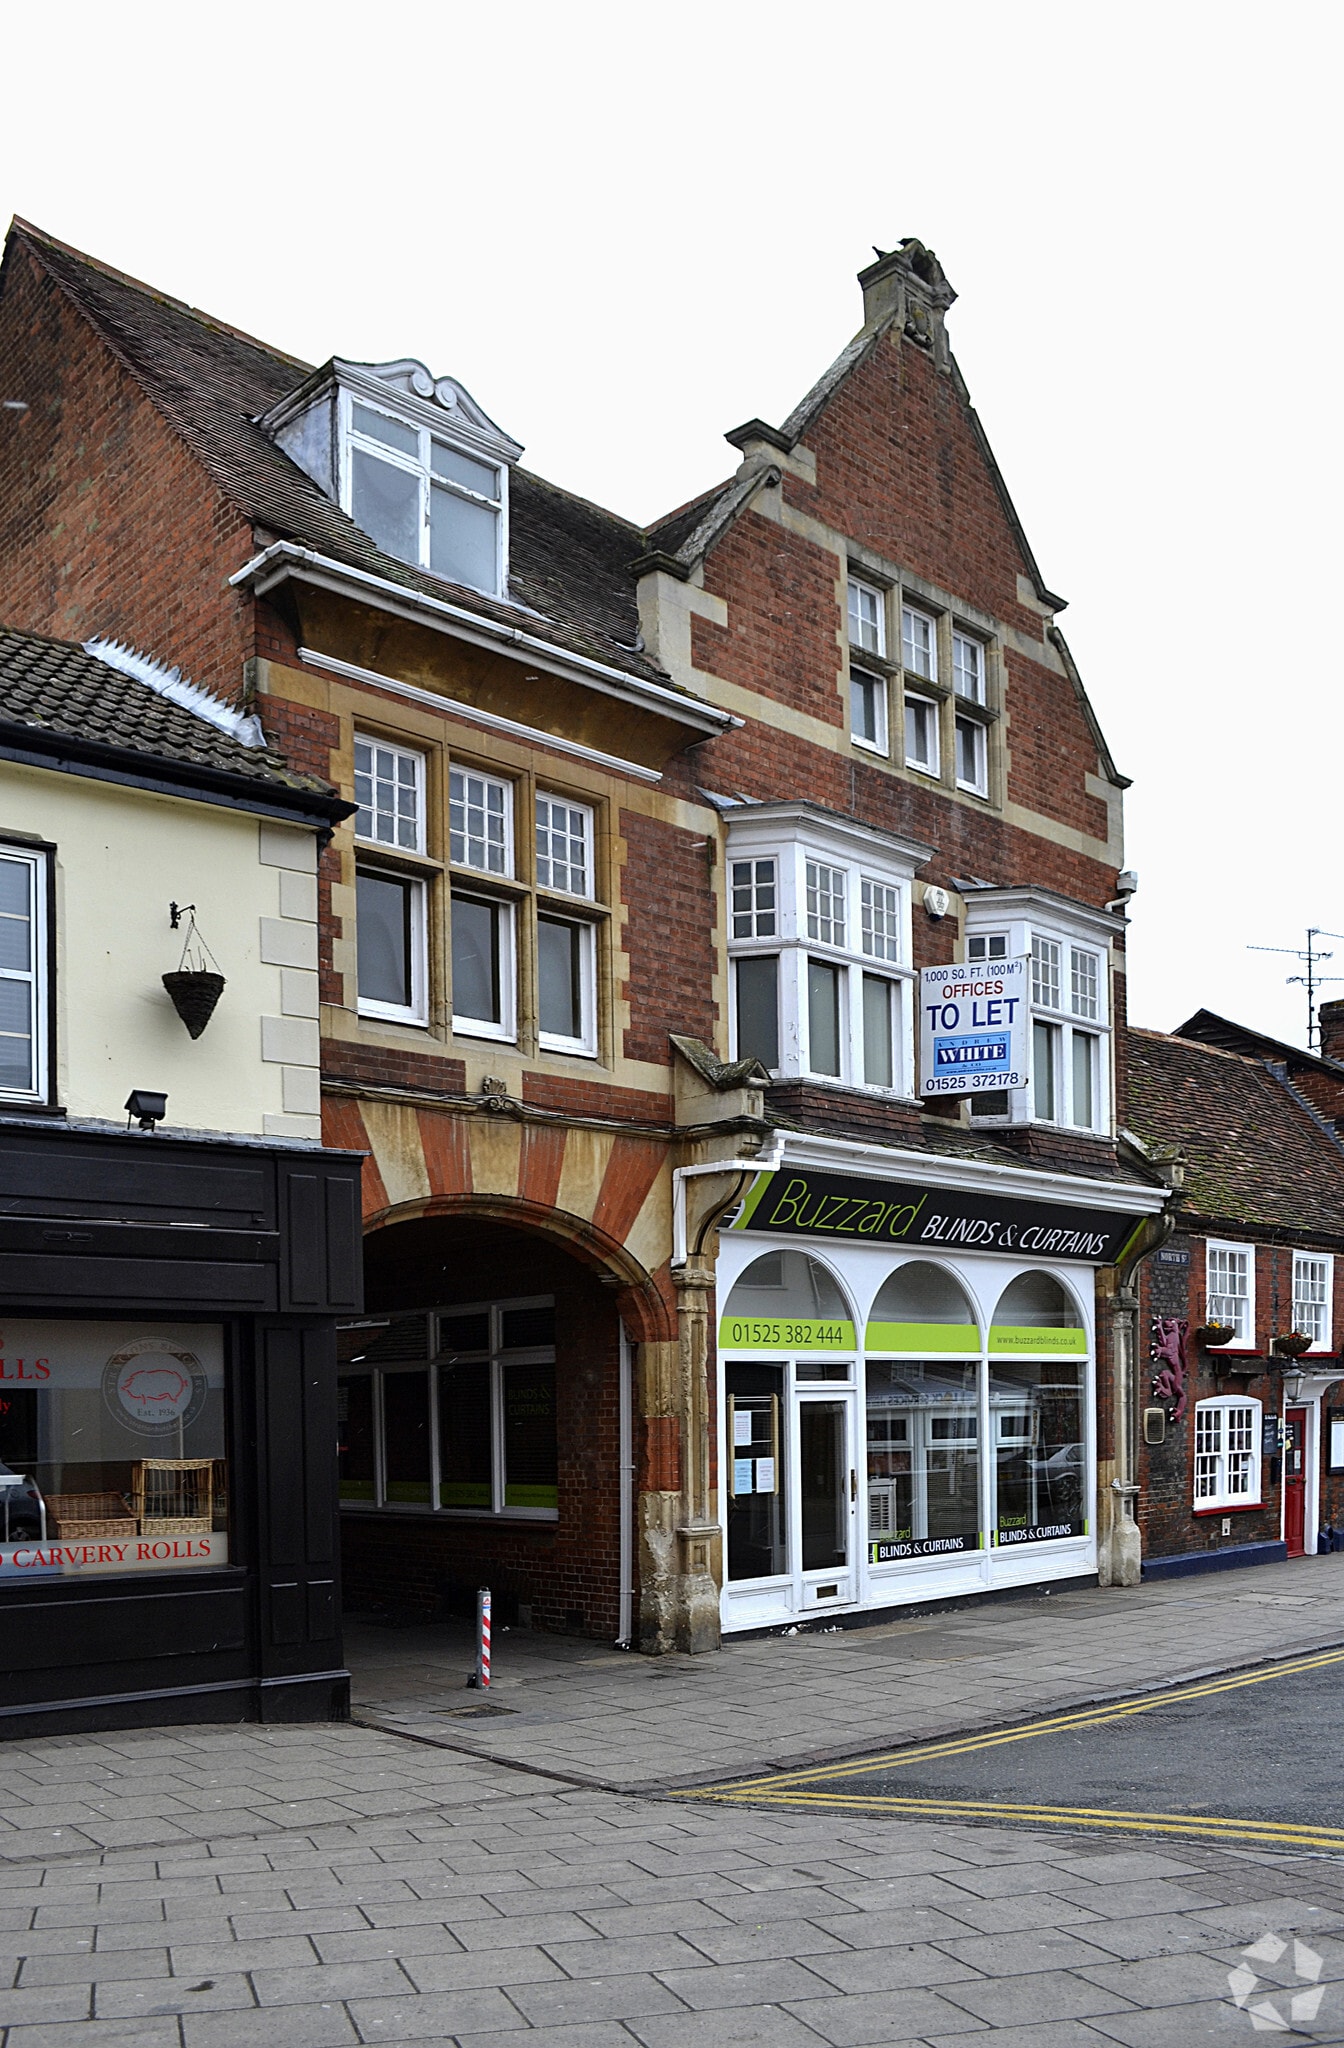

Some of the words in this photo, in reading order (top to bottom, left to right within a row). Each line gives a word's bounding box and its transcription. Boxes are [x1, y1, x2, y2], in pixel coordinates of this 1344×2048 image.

[952, 968, 966, 980] SQ.
[970, 966, 984, 978] FT.
[942, 980, 1004, 998] OFFICES
[926, 1003, 960, 1030] TO
[972, 998, 1020, 1026] LET
[940, 1045, 1004, 1063] WHITE
[926, 1076, 966, 1091] 01525
[972, 1072, 1019, 1087] 372178
[769, 1179, 928, 1236] Buzzard
[920, 1215, 1001, 1245] BLINDS
[998, 1224, 1018, 1247] &
[1019, 1226, 1110, 1255] CURTAINS
[732, 1324, 780, 1342] 01525
[785, 1325, 812, 1344] 382
[816, 1326, 843, 1344] 444
[996, 1336, 1076, 1346] www.buzzardblinds.co.uk
[1000, 1514, 1027, 1528] Buzzard
[1000, 1529, 1027, 1543] BLINDS
[1028, 1528, 1036, 1539] &
[1036, 1524, 1072, 1538] CURTAINS
[12, 1544, 130, 1568] CARVERY
[136, 1539, 211, 1560] ROLLS
[880, 1544, 912, 1558] BLINDS
[914, 1542, 922, 1554] &
[923, 1537, 964, 1553] CURTAINS
